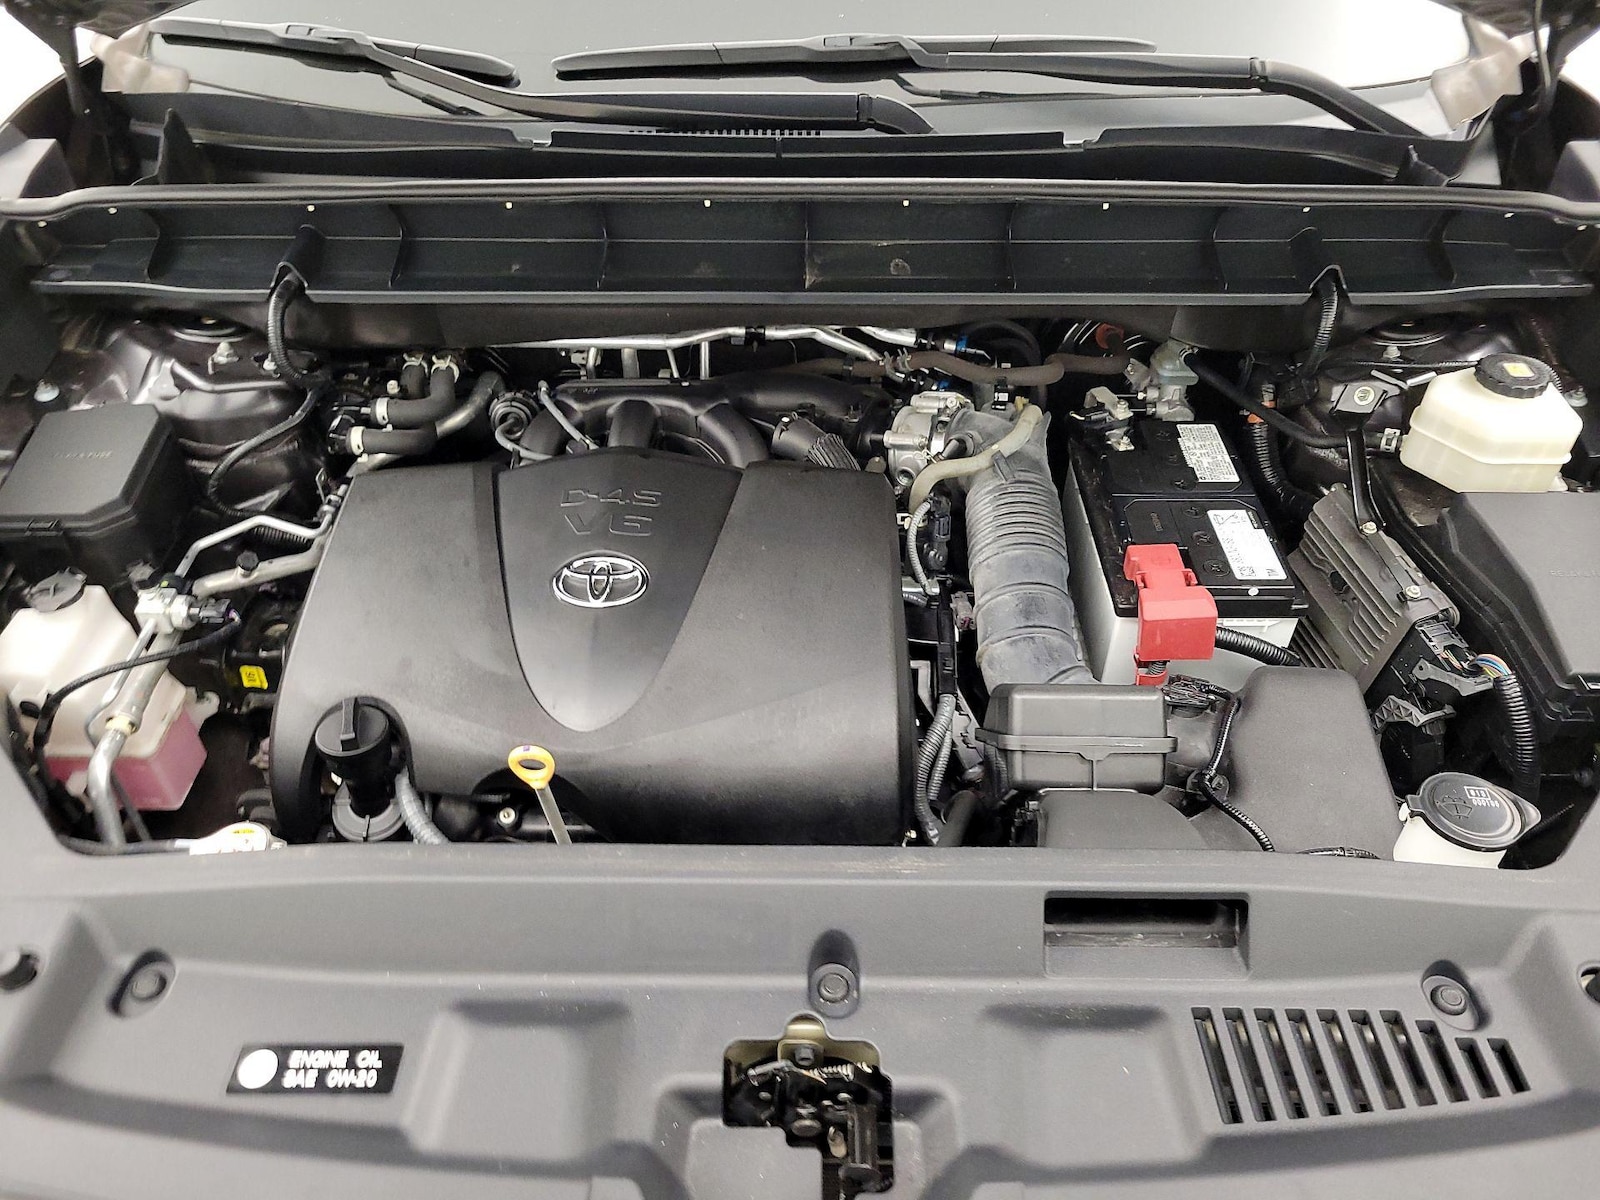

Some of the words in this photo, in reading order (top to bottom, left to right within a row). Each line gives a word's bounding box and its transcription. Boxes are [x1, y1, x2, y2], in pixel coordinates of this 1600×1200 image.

[564, 514, 653, 537] V6
[289, 1049, 349, 1069] ENGINE
[356, 1049, 382, 1069] OIL
[282, 1069, 318, 1088] SAE
[327, 1069, 377, 1088] 0W-20
